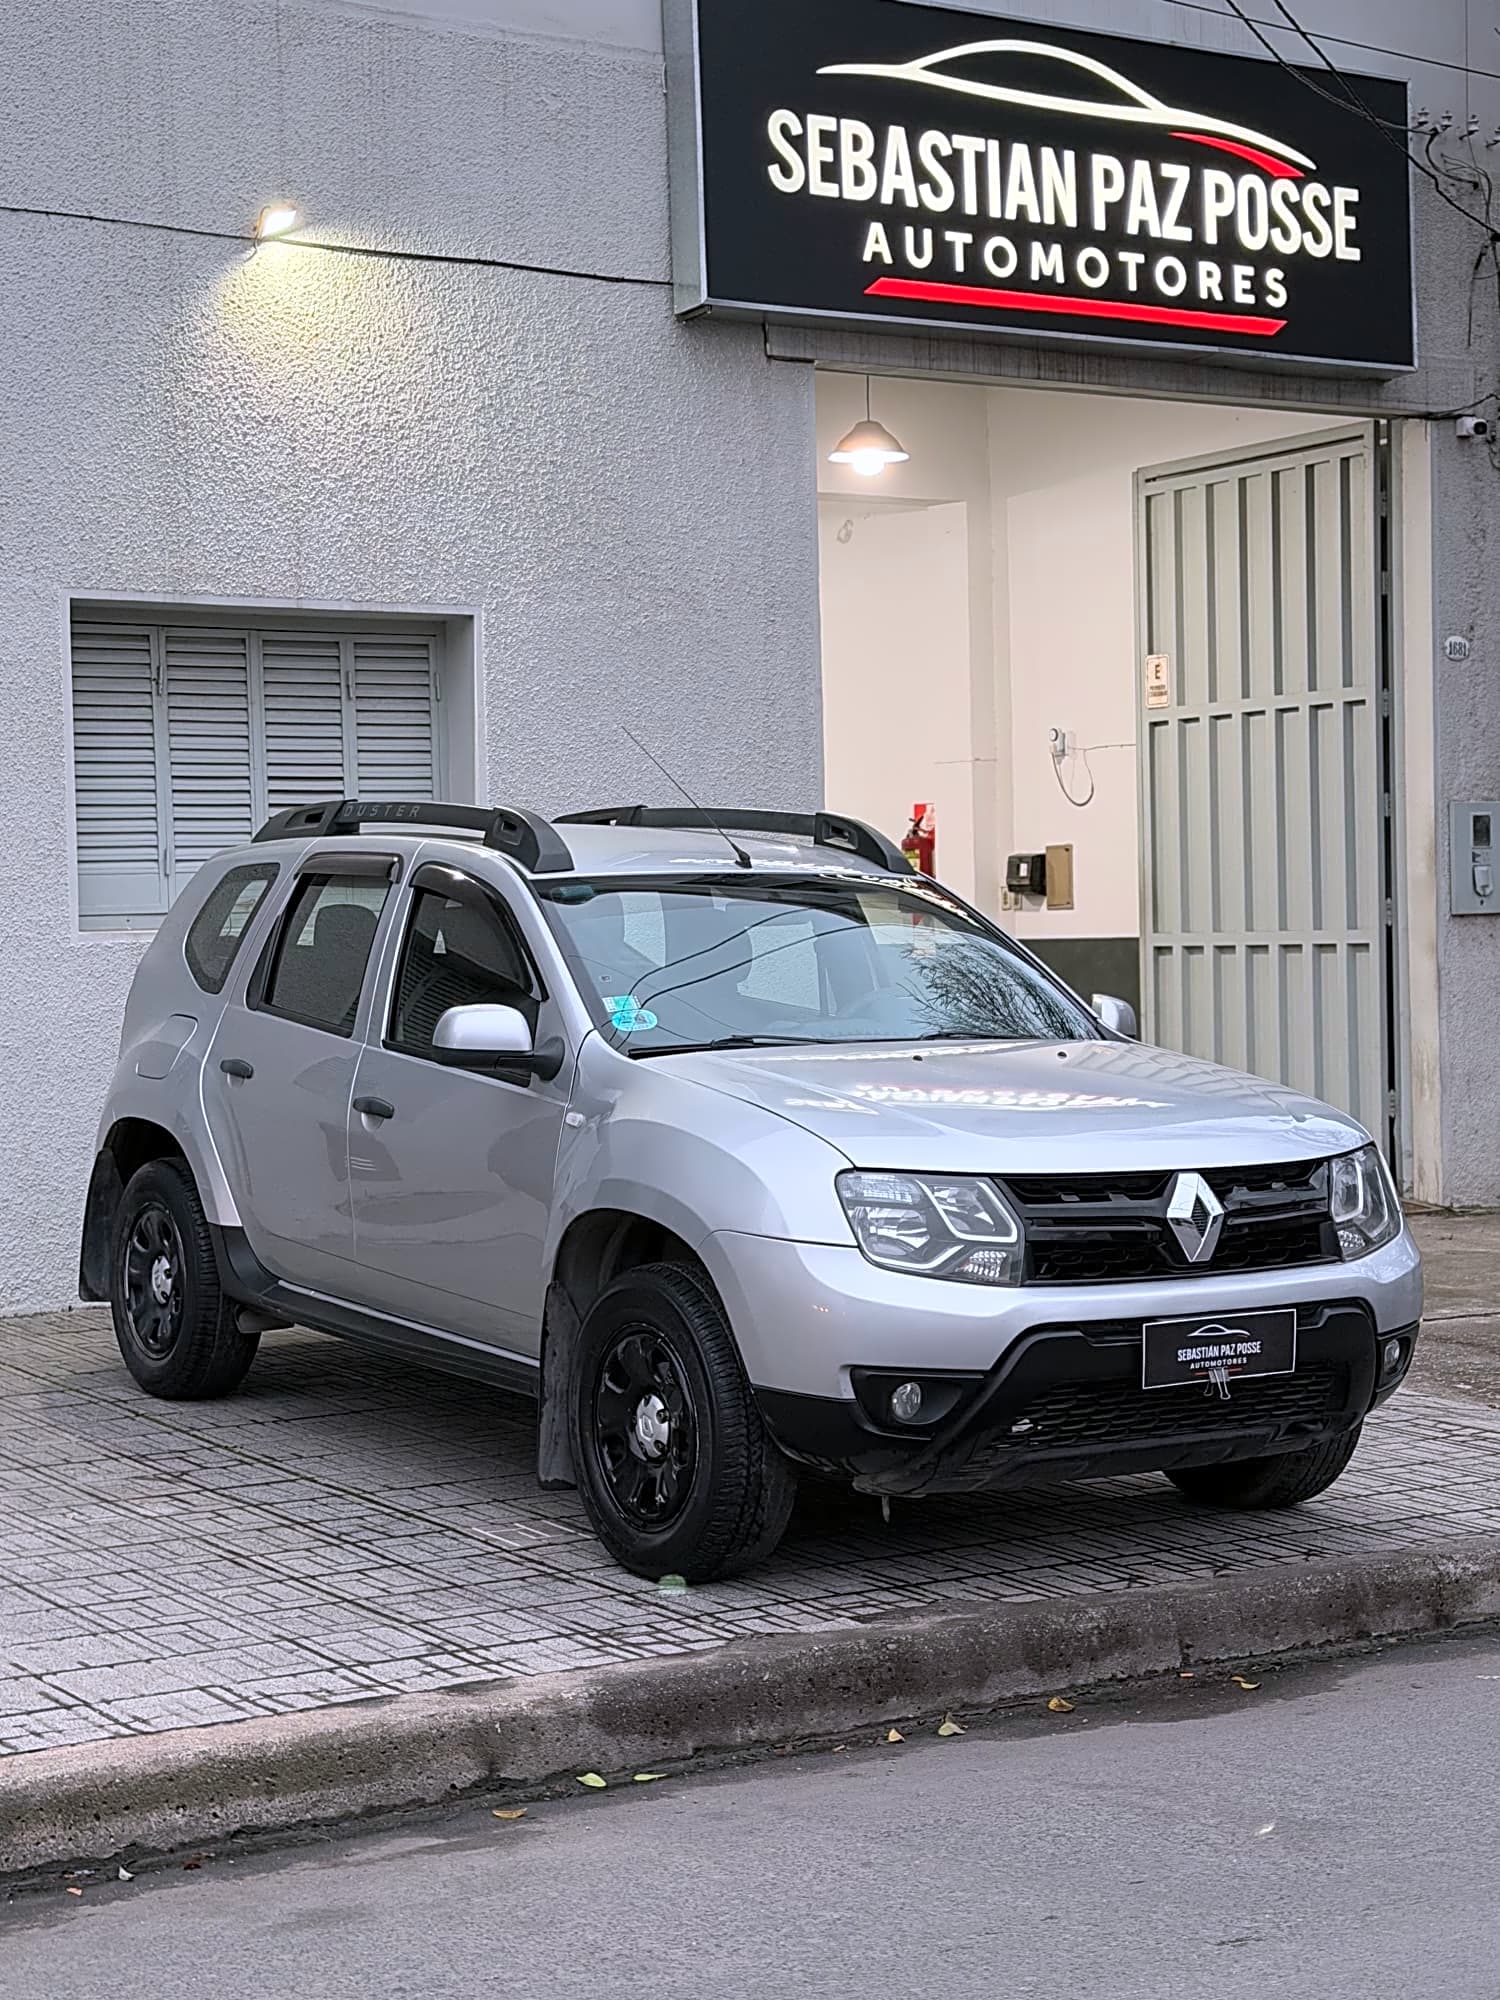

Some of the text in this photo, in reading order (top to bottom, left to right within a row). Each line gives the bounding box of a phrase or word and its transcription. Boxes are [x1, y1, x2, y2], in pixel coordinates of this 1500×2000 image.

[767, 109, 1361, 261] SEBASTIAN PAZ POSSE
[862, 221, 1289, 308] AUTOMOTORES
[343, 804, 421, 817] DUSTER
[1220, 1343, 1236, 1357] PAZ
[1236, 1340, 1262, 1355] POSSE
[1189, 1357, 1247, 1369] AUTOMOTORES
